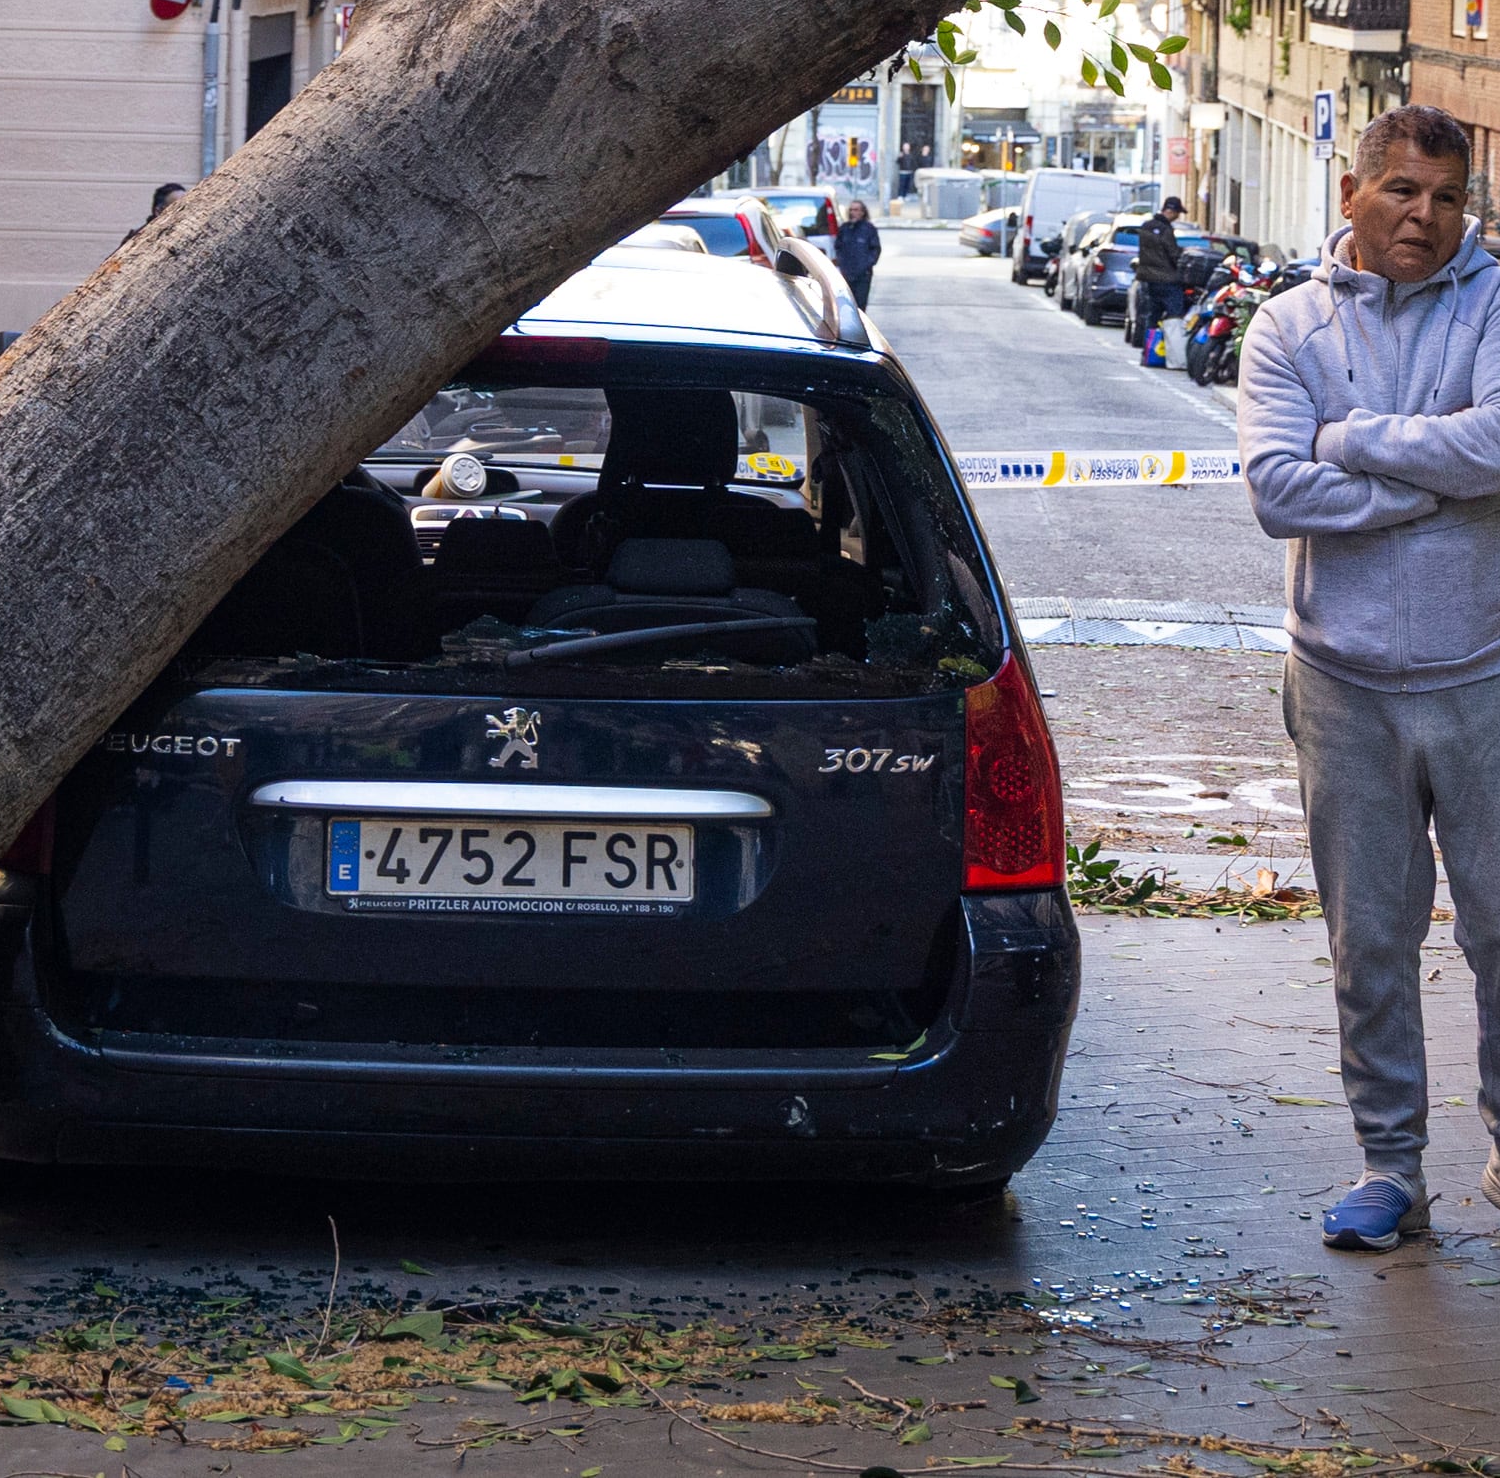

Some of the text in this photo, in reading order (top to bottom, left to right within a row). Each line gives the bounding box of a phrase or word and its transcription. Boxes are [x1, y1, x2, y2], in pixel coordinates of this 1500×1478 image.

[1316, 97, 1330, 138] P
[99, 732, 242, 758] EUGEOT
[817, 747, 894, 773] 307
[338, 827, 678, 892] E 4752 FSR
[359, 900, 408, 909] PEUGEOT
[408, 898, 470, 911] PRITZLER
[471, 899, 564, 913] AUTOMOCION
[577, 902, 620, 914] ROSELLO,
[634, 903, 651, 913] 188
[657, 904, 675, 914] 190
